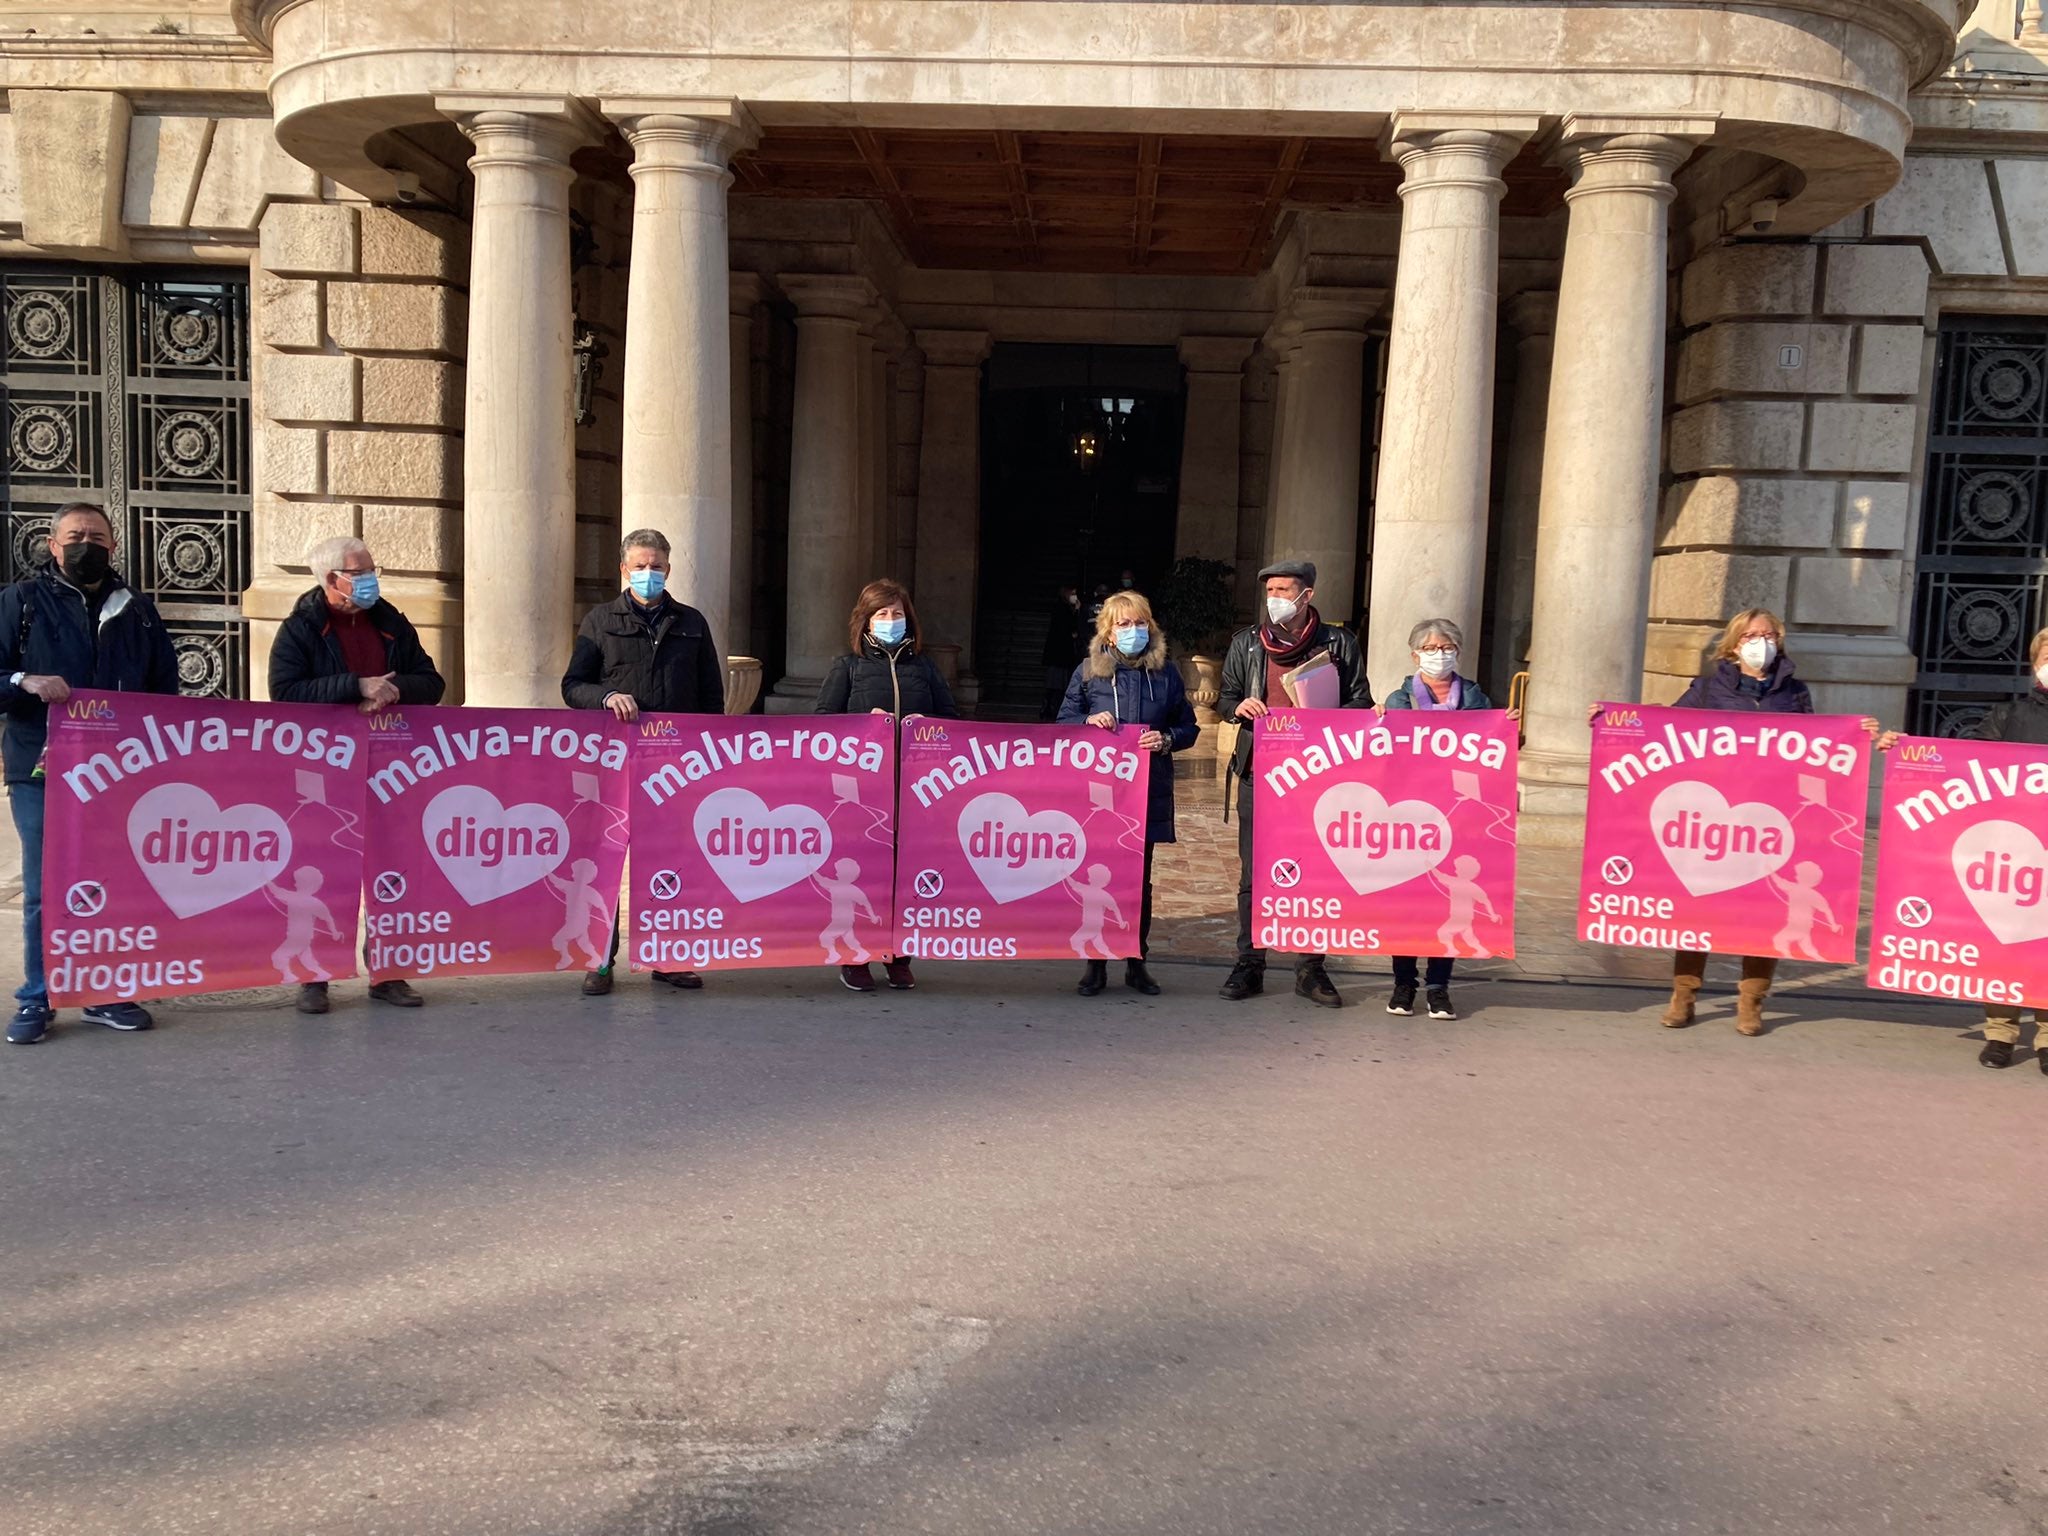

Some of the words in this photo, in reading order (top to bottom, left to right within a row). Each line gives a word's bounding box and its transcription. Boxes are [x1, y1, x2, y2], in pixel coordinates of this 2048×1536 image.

[62, 714, 356, 803] malva-rosa
[367, 724, 628, 805] malva-rosa
[640, 730, 885, 806] malva-rosa
[911, 736, 1139, 808] malva-rosa
[1263, 726, 1507, 798] malva-rosa
[1600, 723, 1857, 794] malva-rosa
[142, 818, 279, 874] digna
[436, 816, 559, 867] digna
[706, 817, 821, 866] digna
[969, 822, 1076, 869] digna
[1326, 811, 1441, 859] digna
[1662, 810, 1783, 861] digna
[367, 910, 451, 938] sense
[639, 906, 723, 932] sense
[902, 906, 981, 928] sense
[1261, 896, 1342, 919] sense
[1588, 893, 1674, 919] sense
[51, 925, 157, 954] sense
[371, 938, 491, 974] drogues
[639, 932, 763, 968] drogues
[902, 928, 1017, 959] drogues
[1261, 918, 1380, 952] drogues
[1881, 934, 1980, 967] sense
[49, 957, 203, 997] drogues
